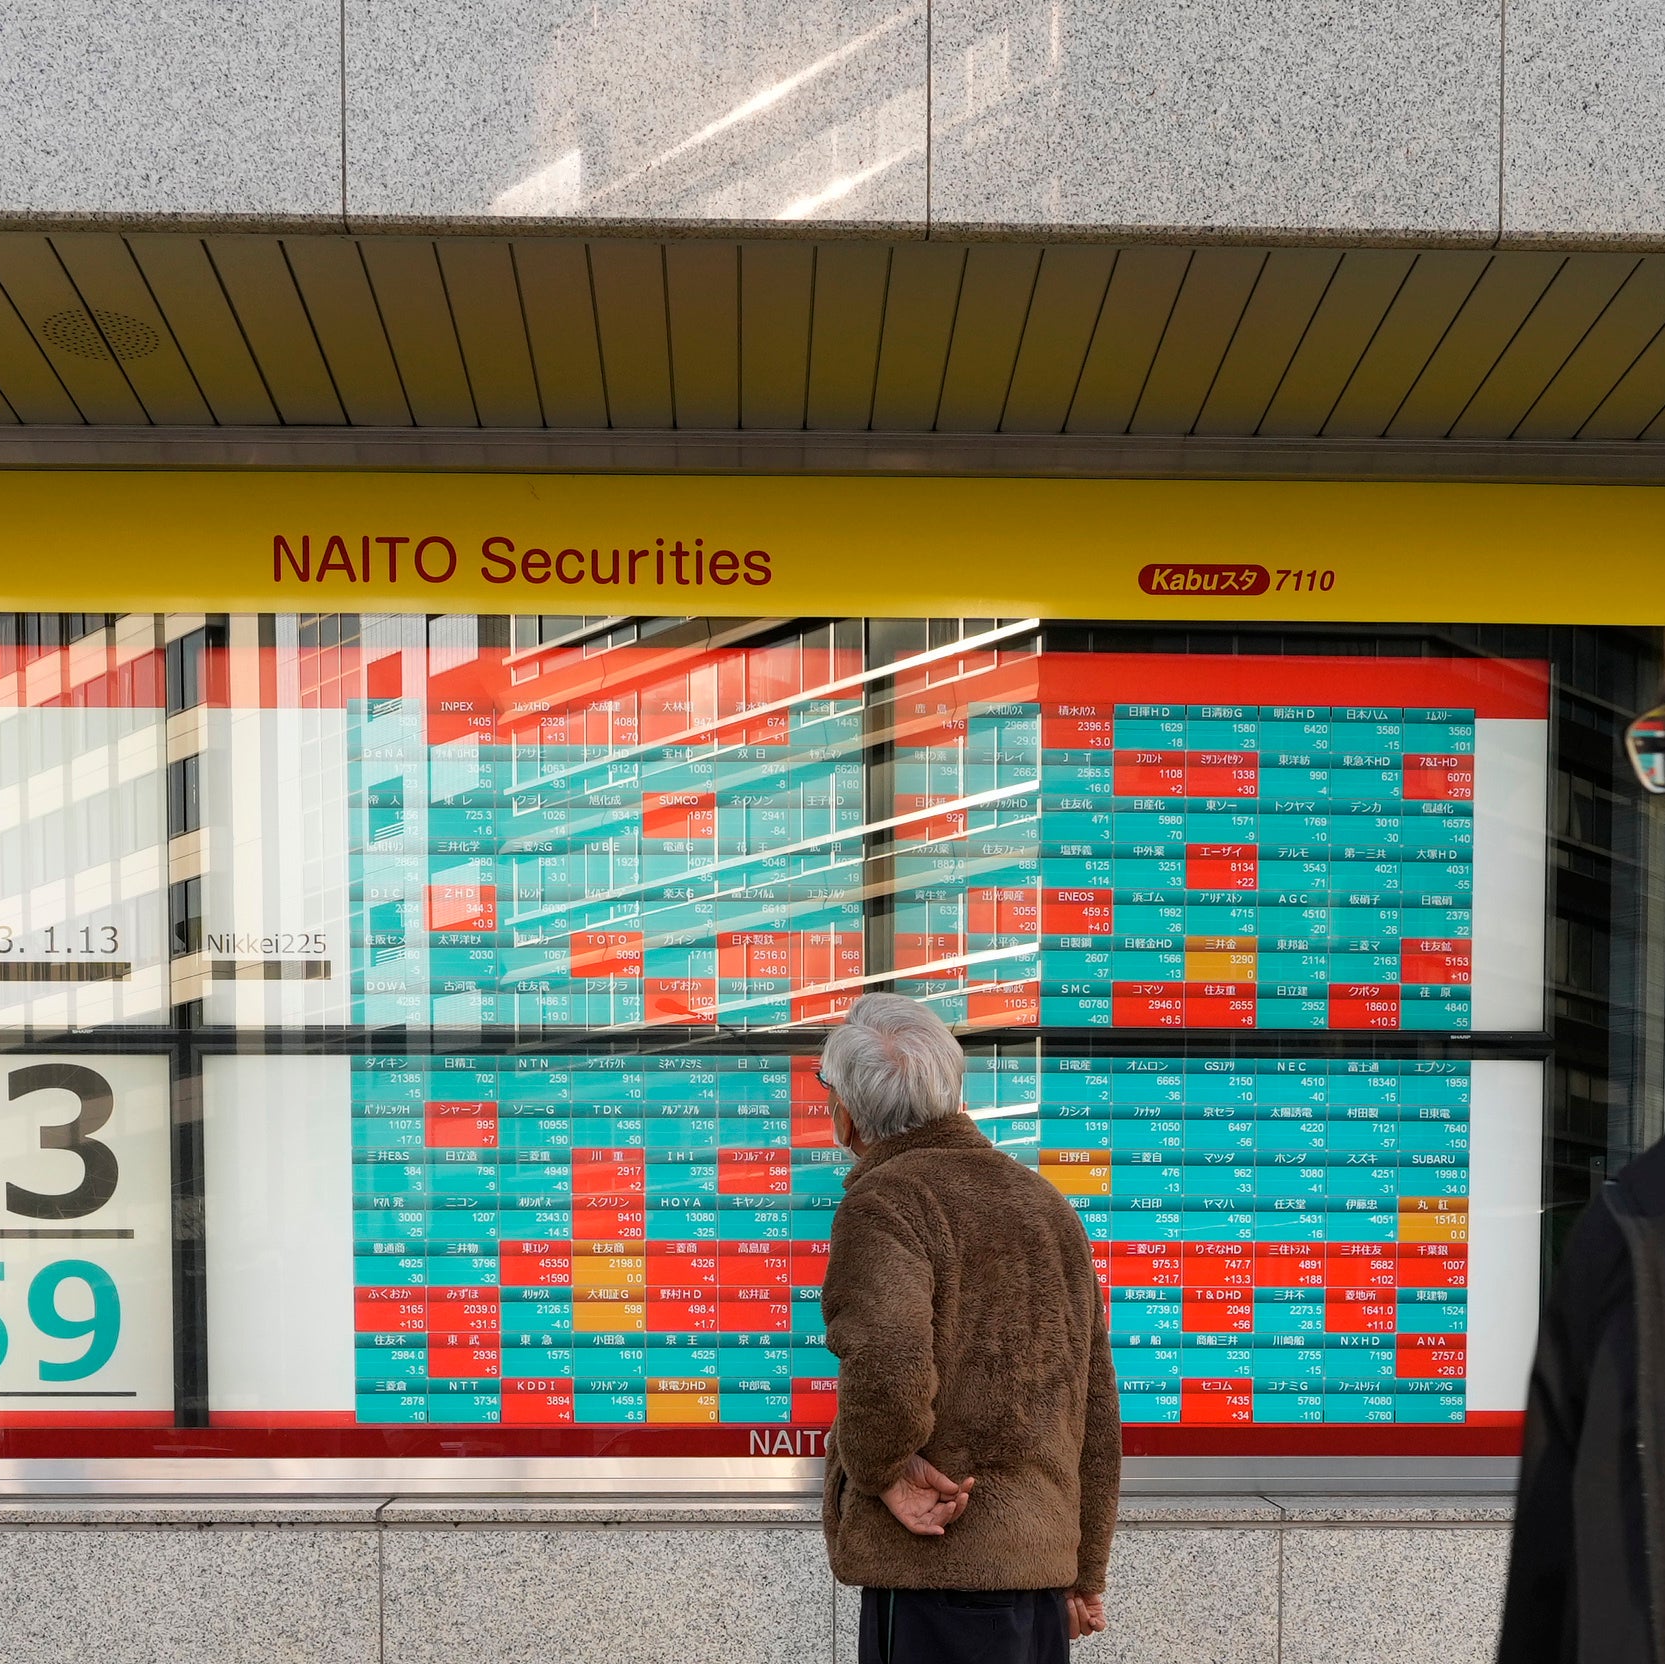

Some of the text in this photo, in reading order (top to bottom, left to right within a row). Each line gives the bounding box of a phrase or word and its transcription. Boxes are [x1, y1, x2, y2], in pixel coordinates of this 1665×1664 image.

[274, 534, 771, 585] NAITO Securities
[1151, 568, 1335, 592] Kabuスタ 7110
[468, 718, 491, 726] 1405
[479, 733, 491, 741] +6
[1419, 757, 1457, 767] 7&I-HD
[1447, 772, 1471, 782] 6070
[1447, 787, 1471, 797] +279
[1060, 800, 1092, 810] 住友化
[1275, 800, 1315, 811] トクヤマ
[689, 812, 712, 820] 1875
[1091, 814, 1108, 823] 471
[1304, 817, 1327, 826] 1769
[701, 827, 712, 835] +9
[1100, 829, 1109, 839] -3
[1311, 831, 1327, 841] -10
[1200, 846, 1241, 857] エーザイ
[1344, 847, 1386, 858] 第一三共
[1230, 862, 1254, 872] 8134
[1374, 864, 1397, 873] 4021
[1236, 877, 1254, 887] +22
[1385, 879, 1398, 888] -23
[1058, 891, 1094, 901] ENEOS
[1082, 907, 1109, 916] 459.5
[1088, 922, 1109, 931] +4.0
[208, 932, 327, 954] Nikkei225
[1205, 938, 1236, 949] 三井金
[754, 951, 786, 959] 2516.0
[1230, 954, 1254, 964] 3290
[1445, 956, 1469, 966] 5153
[760, 966, 786, 975] +48.0
[1247, 969, 1254, 979] 0
[1451, 972, 1468, 981] +10
[1348, 986, 1379, 996] クボタ
[1365, 1002, 1396, 1011] 1860.0
[1370, 1016, 1396, 1026] +10.5
[444, 1057, 475, 1068] 日精工
[1127, 1061, 1168, 1070] オムロン
[1347, 1062, 1379, 1072] 富士通
[1414, 1062, 1456, 1073] エプソン
[475, 1073, 496, 1083] 702
[1156, 1076, 1180, 1085] 6665
[1367, 1077, 1396, 1087] 18340
[1445, 1077, 1469, 1087] 1959
[484, 1088, 496, 1098] -1
[1165, 1091, 1180, 1100] -36
[1380, 1092, 1396, 1101] -15
[1457, 1093, 1469, 1103] -2
[440, 1103, 482, 1114] シャープ
[1203, 1107, 1234, 1117] 京セラ
[1419, 1108, 1450, 1118] 日東電
[476, 1119, 494, 1129] 995
[1228, 1122, 1252, 1131] 6497
[1372, 1123, 1394, 1132] 7121
[1444, 1123, 1467, 1133] 7640
[482, 1135, 494, 1144] +7
[1236, 1137, 1252, 1146] -56
[1380, 1138, 1395, 1147] -57
[1445, 1138, 1468, 1148] -150
[445, 1150, 477, 1161] 日立造
[1059, 1152, 1089, 1162] 日野自
[1274, 1153, 1307, 1163] ホンダ
[1412, 1154, 1455, 1164] SUBARU
[477, 1166, 495, 1175] 796
[544, 1165, 571, 1175] 4949
[1089, 1167, 1108, 1176] 497
[1300, 1168, 1323, 1178] 3080
[1435, 1169, 1466, 1179] 1998.0
[485, 1181, 497, 1190] -9
[552, 1180, 571, 1192] -43
[1101, 1182, 1109, 1192] 0
[1307, 1183, 1322, 1192] -41
[1442, 1184, 1466, 1193] -34.0
[587, 1197, 629, 1207] スクリン
[733, 1197, 775, 1207] キヤノン
[617, 1212, 641, 1221] 9410
[754, 1212, 787, 1222] 2878.5
[617, 1227, 642, 1237] +280
[762, 1227, 787, 1237] -20.5
[592, 1242, 624, 1253] 住友商
[666, 1242, 696, 1253] 三菱商
[738, 1242, 769, 1253] 高島屋
[1127, 1243, 1166, 1254] 三菱UFJ
[1342, 1244, 1381, 1255] 三井住友
[1419, 1244, 1448, 1255] 千葉銀
[609, 1258, 642, 1268] 2198.0
[690, 1258, 715, 1268] 4326
[764, 1258, 786, 1267] 1731
[1152, 1259, 1179, 1268] 975.3
[1370, 1260, 1393, 1269] 5682
[1442, 1260, 1465, 1270] 1007
[626, 1273, 642, 1283] 0.0
[702, 1274, 714, 1282] +4
[775, 1273, 787, 1283] +5
[1152, 1274, 1179, 1283] +21.7
[1370, 1275, 1393, 1284] +102
[1447, 1275, 1465, 1284] +28
[368, 1288, 411, 1299] ふくおか
[446, 1288, 478, 1299] みずほ
[1125, 1288, 1166, 1300] 東京海上
[399, 1304, 423, 1314] 3165
[463, 1304, 496, 1314] 2039.0
[1146, 1304, 1179, 1314] 2739.0
[1362, 1305, 1393, 1315] 1641.0
[399, 1319, 424, 1328] +130
[469, 1319, 497, 1328] +31.5
[1154, 1319, 1179, 1329] -34.5
[1366, 1320, 1393, 1329] +11.0
[374, 1334, 406, 1345] 住友不
[391, 1350, 424, 1359] 2984.0
[405, 1365, 425, 1374] -3.5
[738, 1380, 771, 1390] 中部電
[1201, 1380, 1232, 1390] セコム
[765, 1395, 788, 1404] 1270
[1226, 1395, 1249, 1405] 7435
[778, 1410, 789, 1421] -4
[1231, 1410, 1249, 1420] +34
[749, 1430, 830, 1456] NAIT
